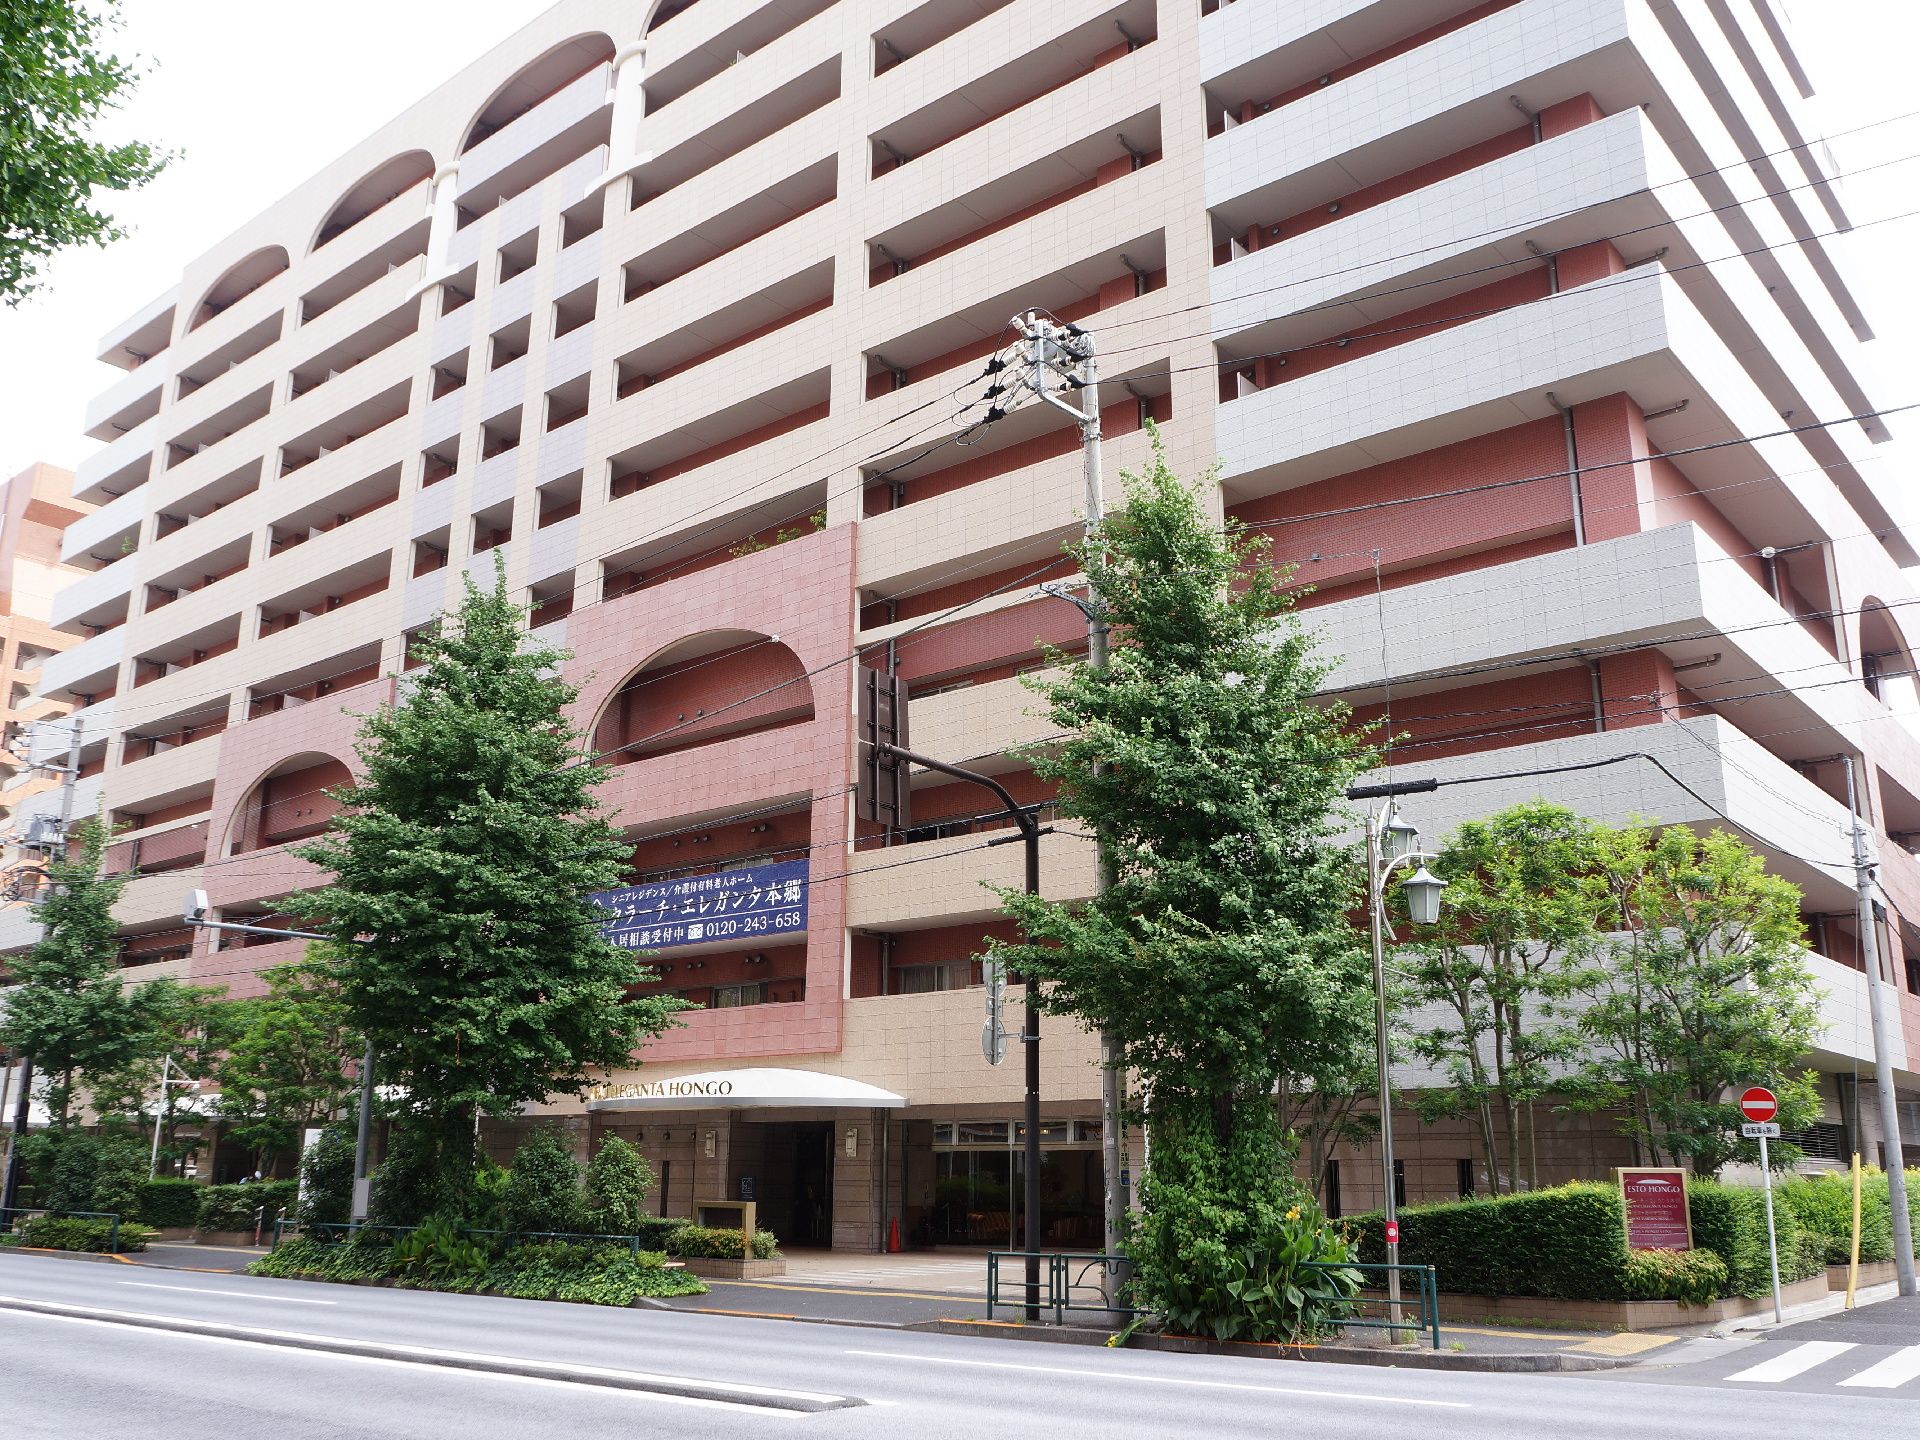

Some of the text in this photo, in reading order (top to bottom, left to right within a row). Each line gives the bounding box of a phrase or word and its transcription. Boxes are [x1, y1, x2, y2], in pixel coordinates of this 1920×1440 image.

[706, 911, 801, 936] 0120-243-658
[669, 1080, 733, 1096] HONGO
[1627, 1185, 1681, 1193] ESTO HONGO
